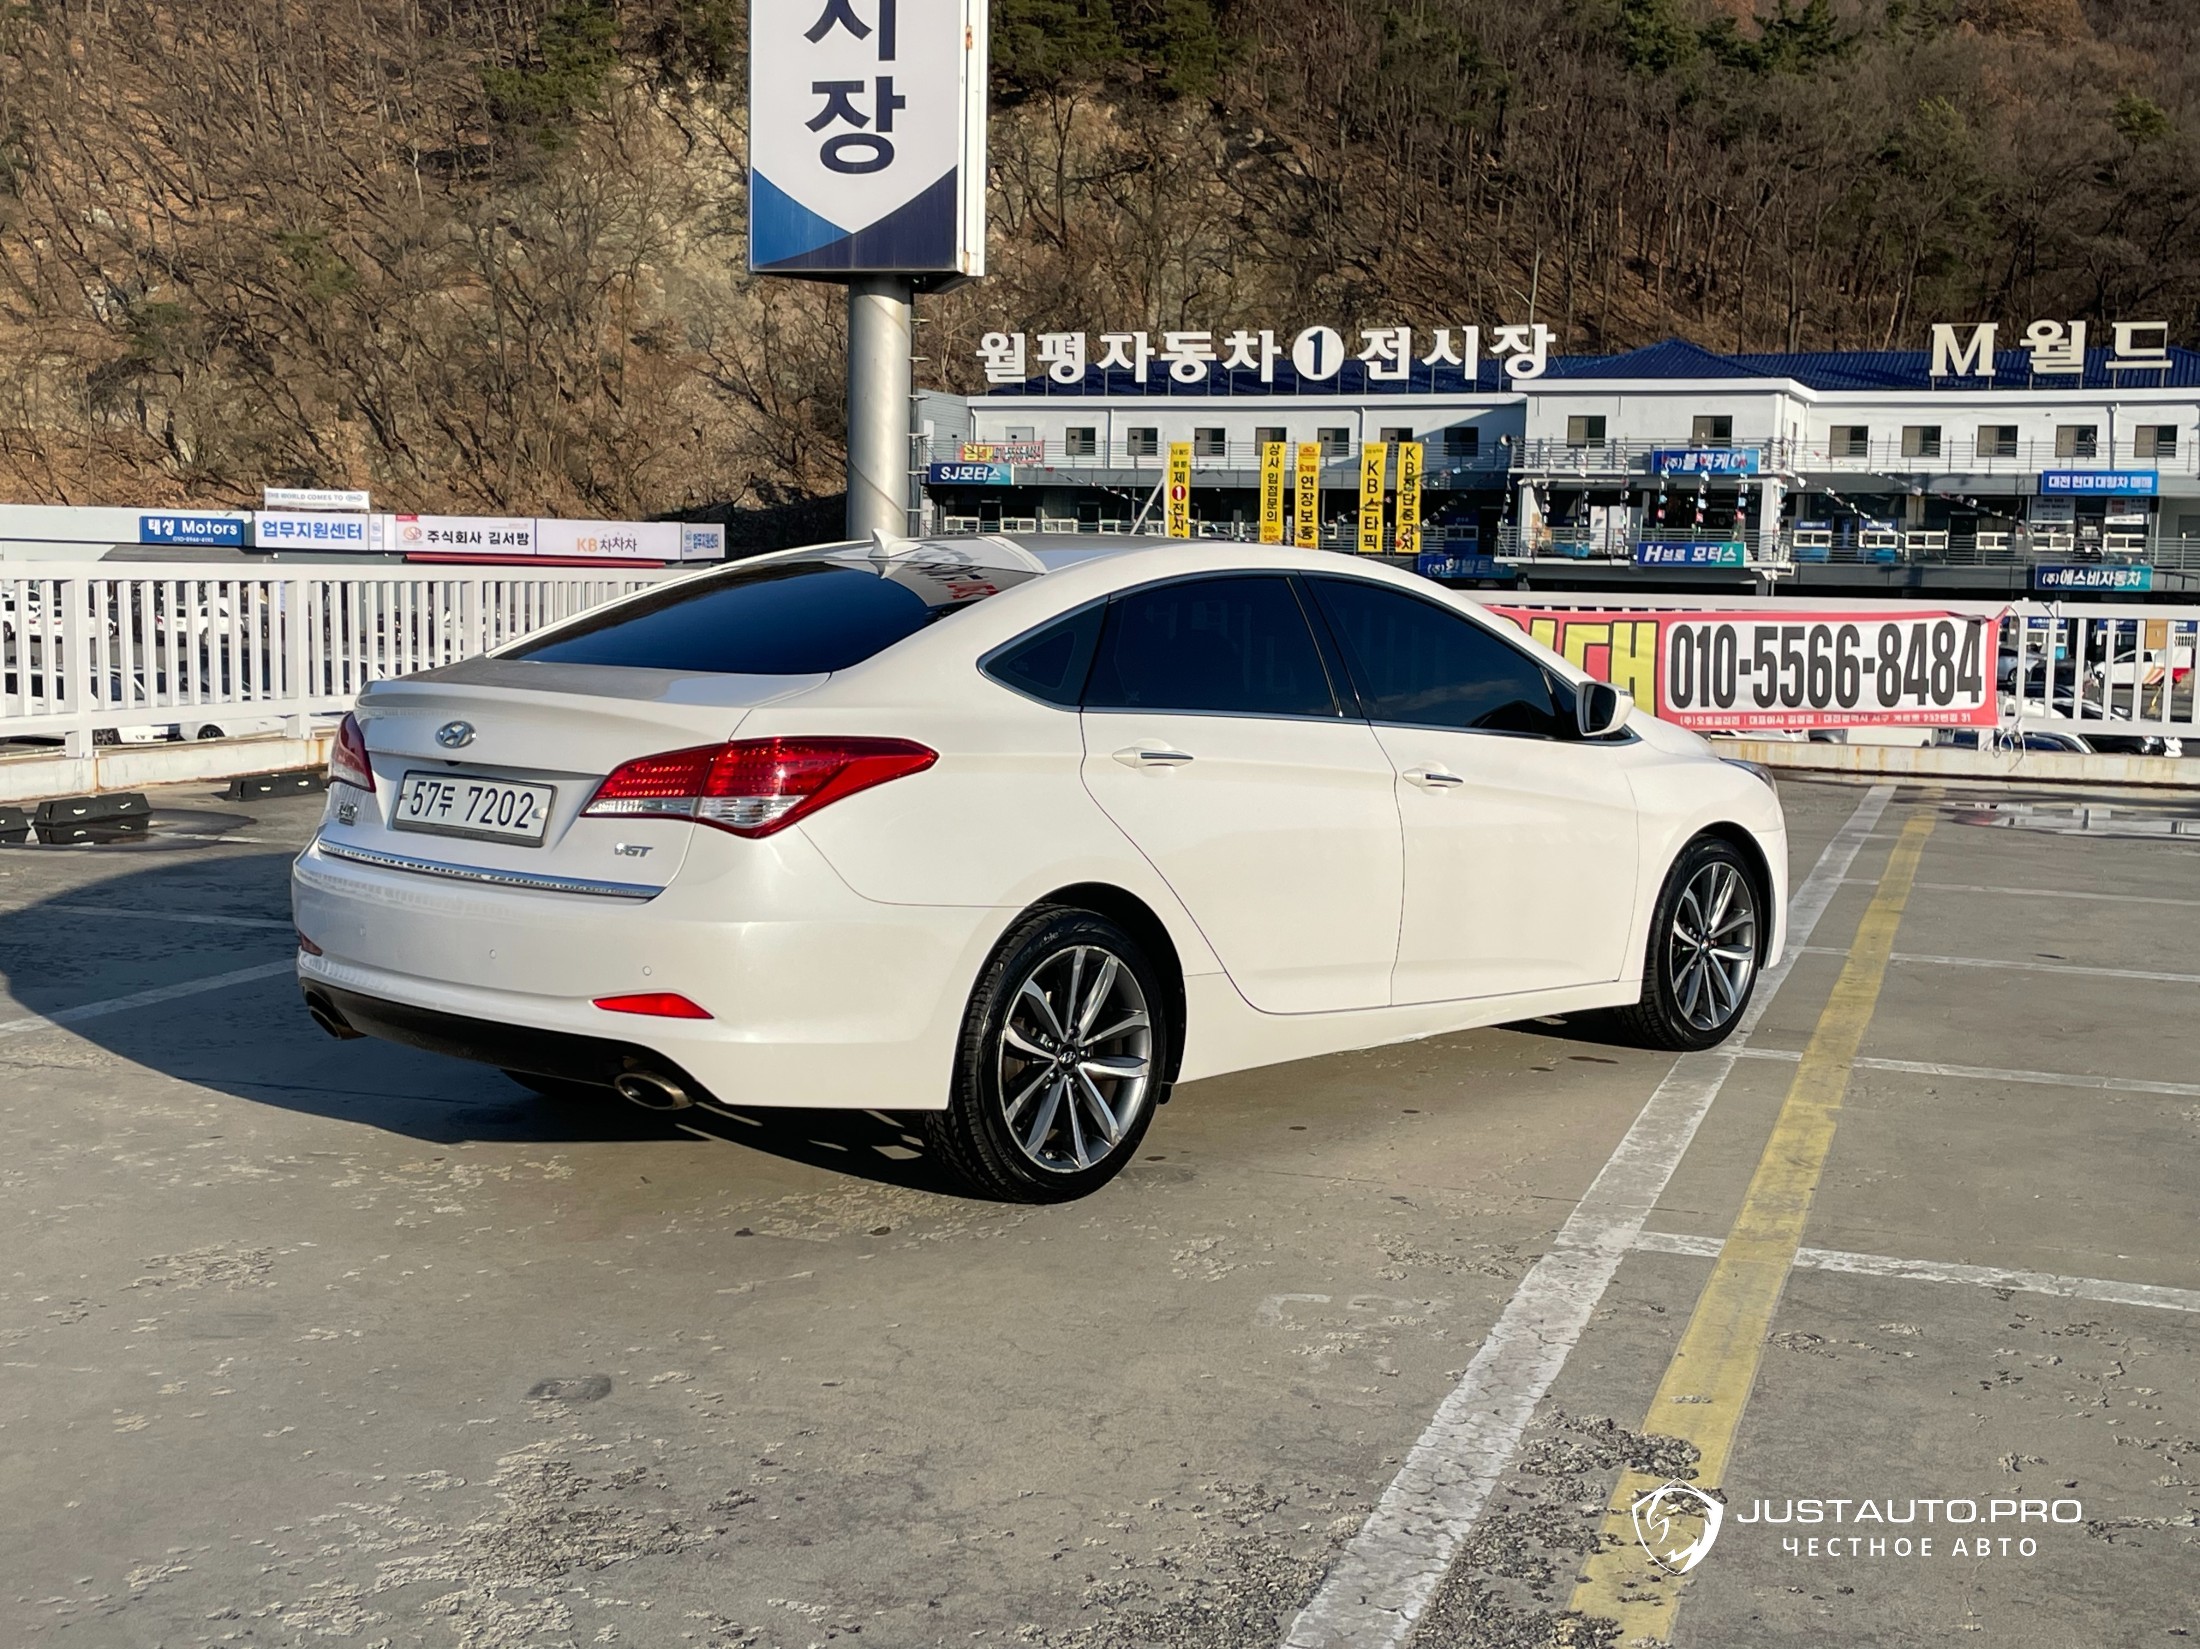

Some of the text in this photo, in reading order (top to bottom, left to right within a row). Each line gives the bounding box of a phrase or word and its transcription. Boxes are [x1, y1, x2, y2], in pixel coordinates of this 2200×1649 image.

[940, 466, 1001, 481] SJ모터스
[182, 520, 238, 536] Motors
[262, 520, 363, 540] 업무지원센터
[427, 530, 530, 546] 주식회사 김서방
[1692, 546, 1737, 562] 모터스
[1670, 614, 1983, 710] 010-5566-8484
[465, 786, 535, 830] 7202
